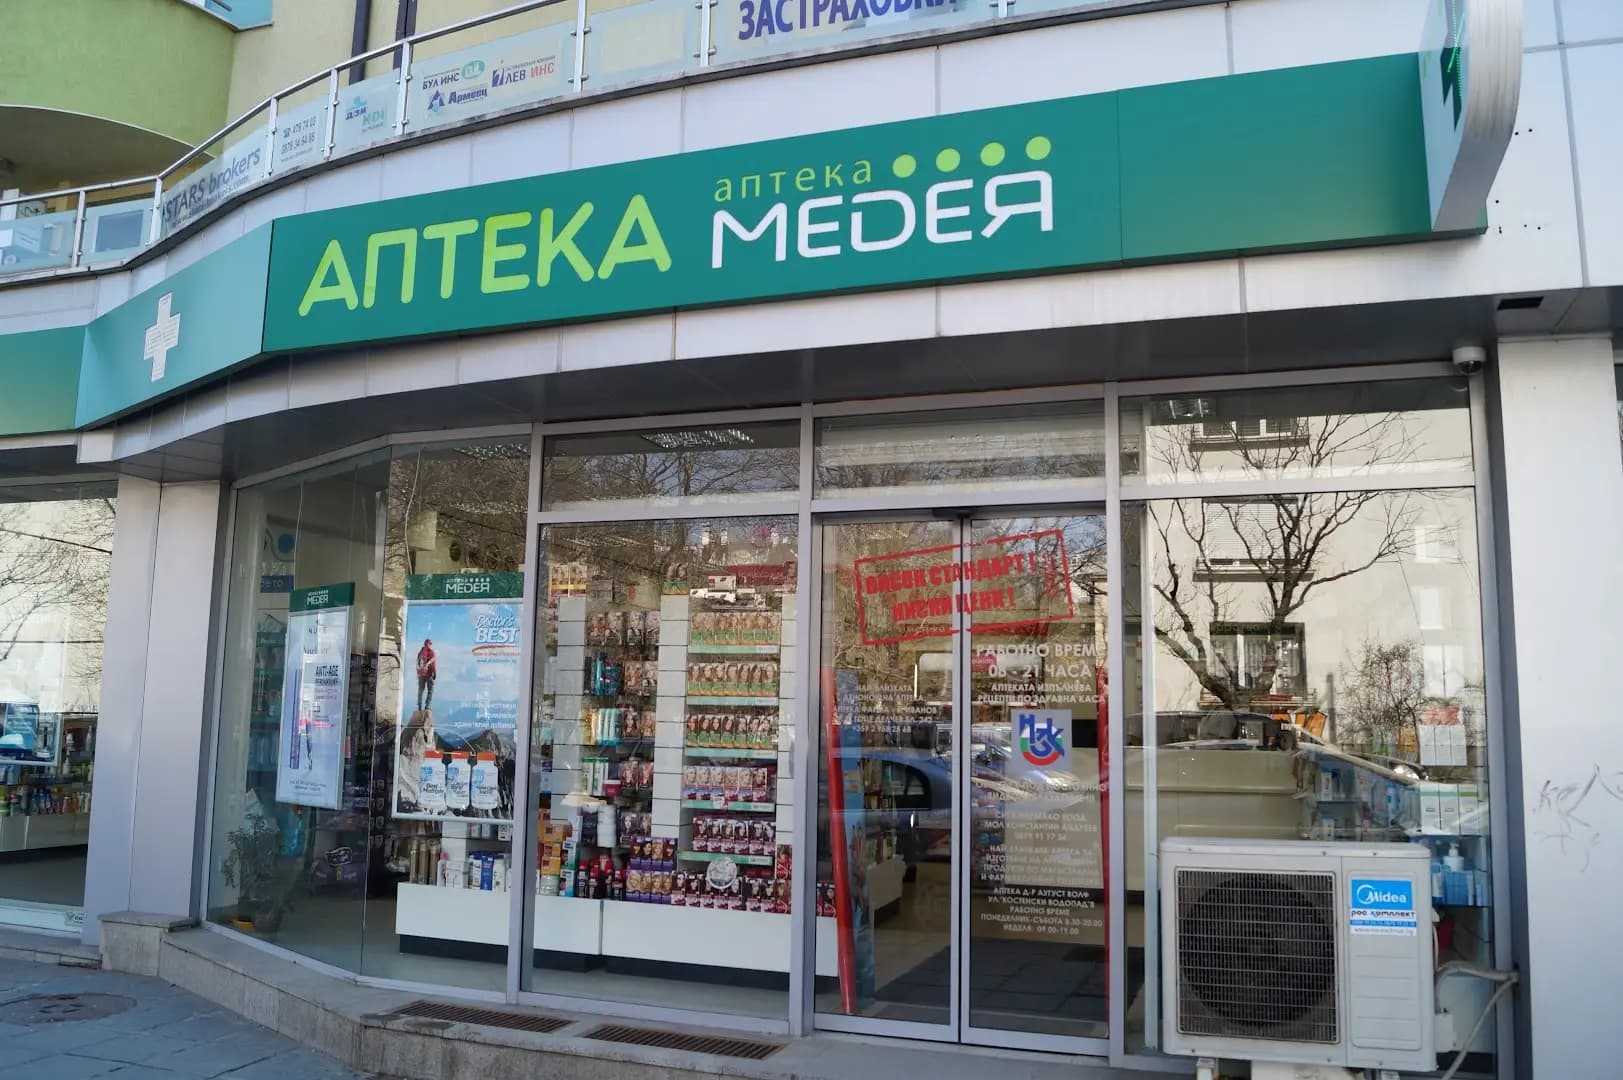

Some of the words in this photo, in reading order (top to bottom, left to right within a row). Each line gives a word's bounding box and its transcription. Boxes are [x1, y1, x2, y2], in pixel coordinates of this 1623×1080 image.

[422, 79, 439, 90] БУЛ
[440, 73, 460, 84] ИНС
[505, 70, 526, 84] ЛЕВ
[530, 63, 554, 78] ИНС
[164, 178, 206, 221] STARS
[208, 148, 261, 194] brokers
[714, 159, 872, 201] аптека
[298, 194, 672, 317] АПТЕКА
[865, 569, 926, 594] ВИСОК
[892, 597, 952, 622] НИСКИ
[475, 628, 519, 643] BEST
[976, 643, 1050, 657] РАБОТНО
[1055, 643, 1106, 657] ВРЕМЕ
[1022, 665, 1039, 677] 21
[1045, 664, 1092, 678] ЧАСА
[991, 683, 1036, 692] АПТЕКАТА
[1038, 683, 1092, 692] ИЗПЪЛНЯВА
[978, 694, 1015, 702] РЕЦЕПТИ
[993, 887, 1020, 895] АПТЕКА
[1359, 886, 1407, 904] Midea
